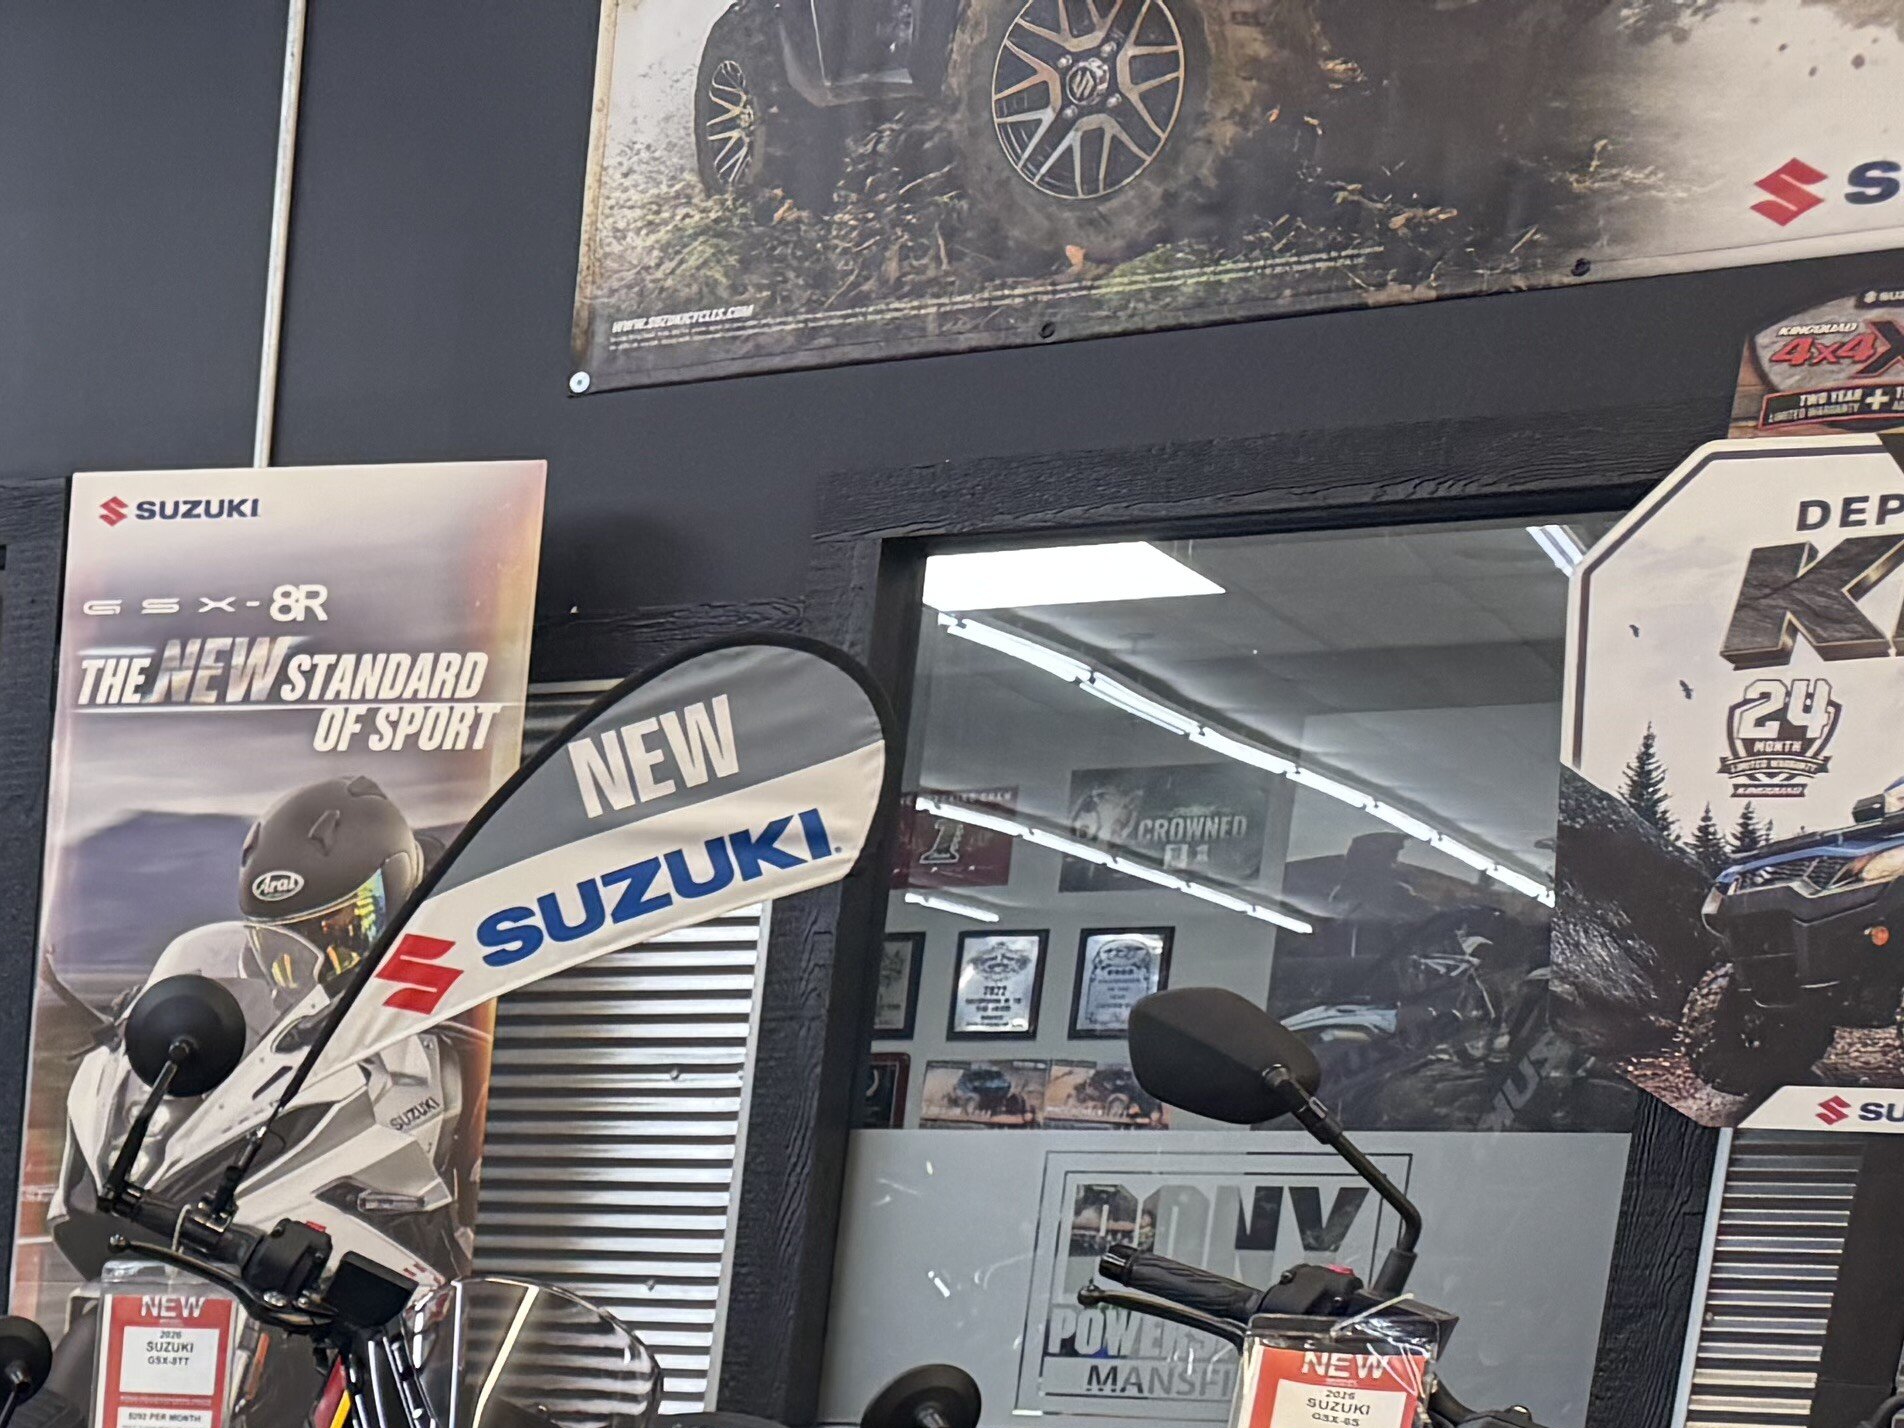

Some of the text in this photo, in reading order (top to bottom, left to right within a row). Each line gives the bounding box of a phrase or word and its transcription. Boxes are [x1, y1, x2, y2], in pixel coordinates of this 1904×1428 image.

[135, 498, 260, 521] SUZUKI
[78, 636, 489, 706] THE NEW STANDARD
[1737, 678, 1833, 740] 24
[313, 704, 502, 752] OF SPORT
[568, 694, 740, 820] NEW
[1754, 741, 1801, 753] MONTH
[1138, 816, 1248, 841] CROWNED
[477, 808, 832, 968] SUZUKI
[389, 1097, 440, 1132] SUZUKI
[141, 1294, 206, 1318] NEW
[146, 1342, 195, 1353] SUZUKI
[1301, 1351, 1390, 1379] NEW
[149, 1413, 167, 1422] PER
[169, 1414, 202, 1424] MONTH
[1306, 1398, 1372, 1416] SUZUKI
